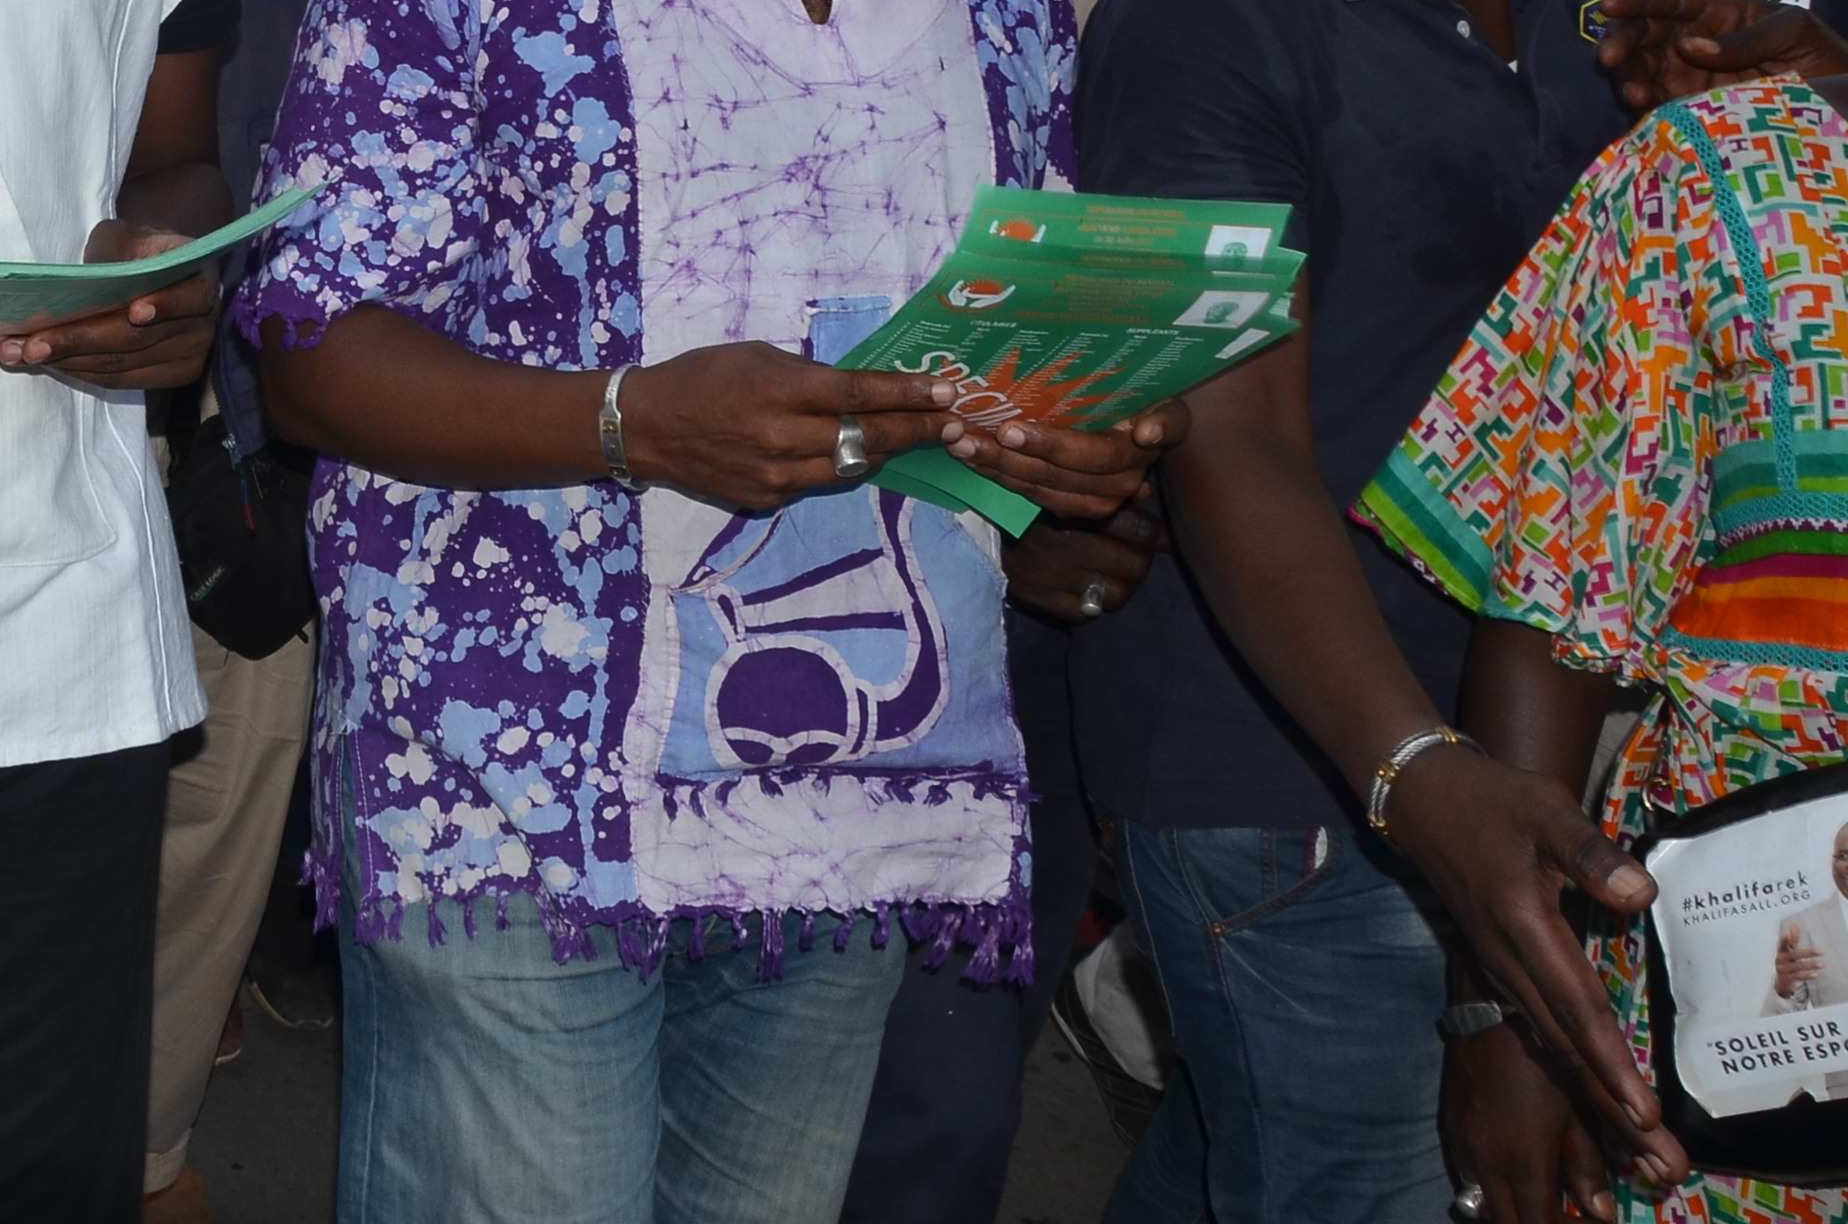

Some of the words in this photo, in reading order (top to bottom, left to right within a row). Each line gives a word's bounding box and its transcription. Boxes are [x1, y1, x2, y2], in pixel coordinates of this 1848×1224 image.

[1681, 871, 1809, 912] #khalifarek
[1683, 889, 1811, 927] KHALIFASALL.ORG
[1796, 1020, 1842, 1042] SUR
[1721, 1048, 1796, 1075] NOTRE
